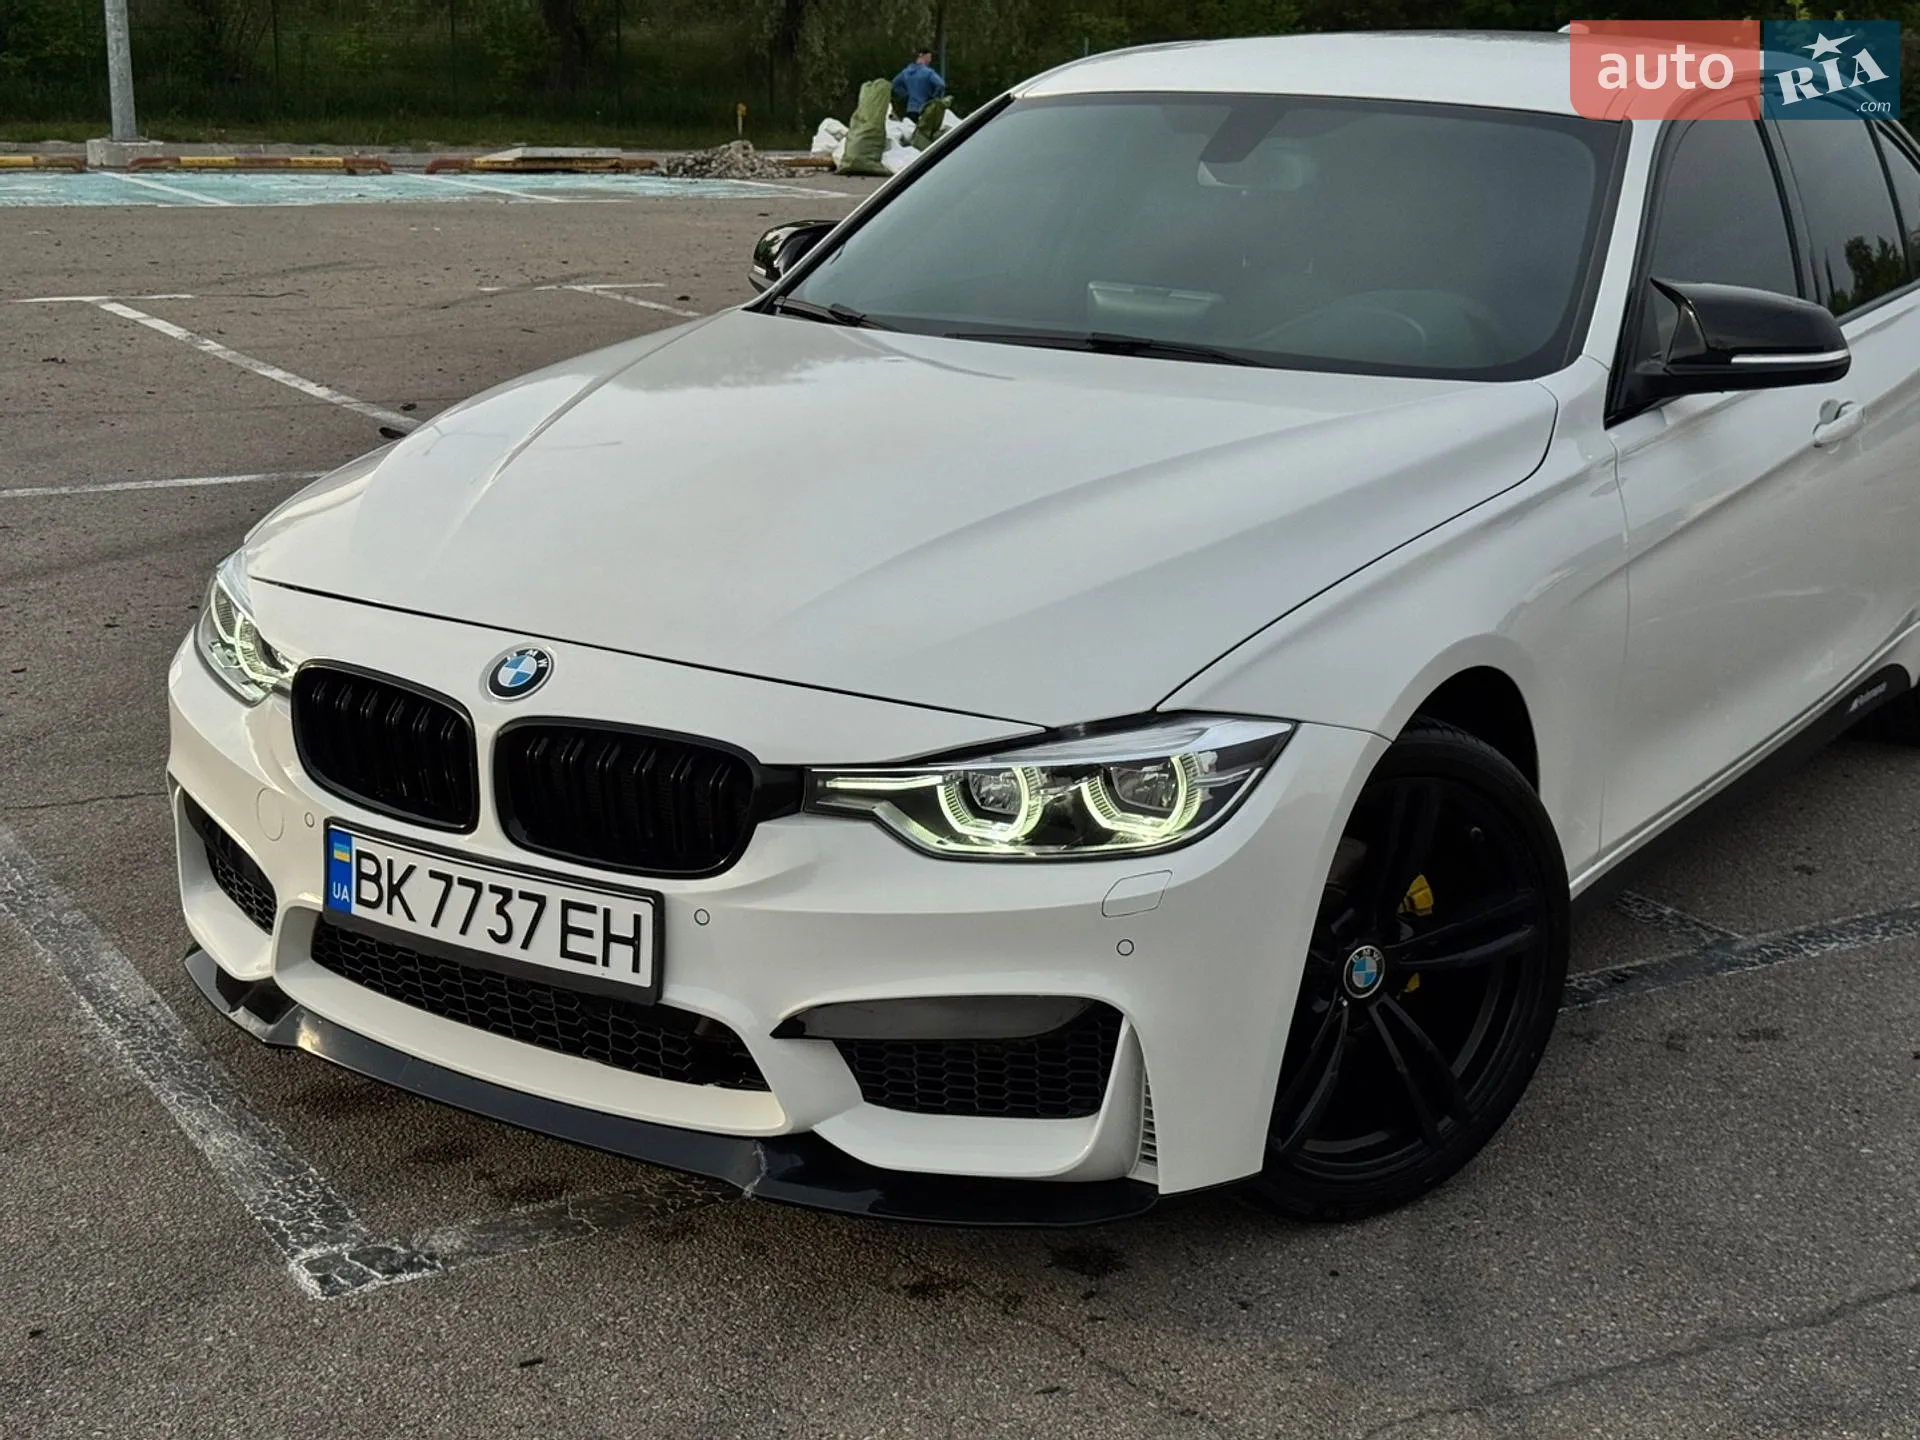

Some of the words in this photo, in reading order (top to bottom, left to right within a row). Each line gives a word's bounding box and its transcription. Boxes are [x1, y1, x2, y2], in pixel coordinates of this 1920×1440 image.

[333, 881, 350, 903] UA
[355, 849, 417, 922] BK
[428, 869, 547, 950] 7737
[560, 899, 641, 973] EH
